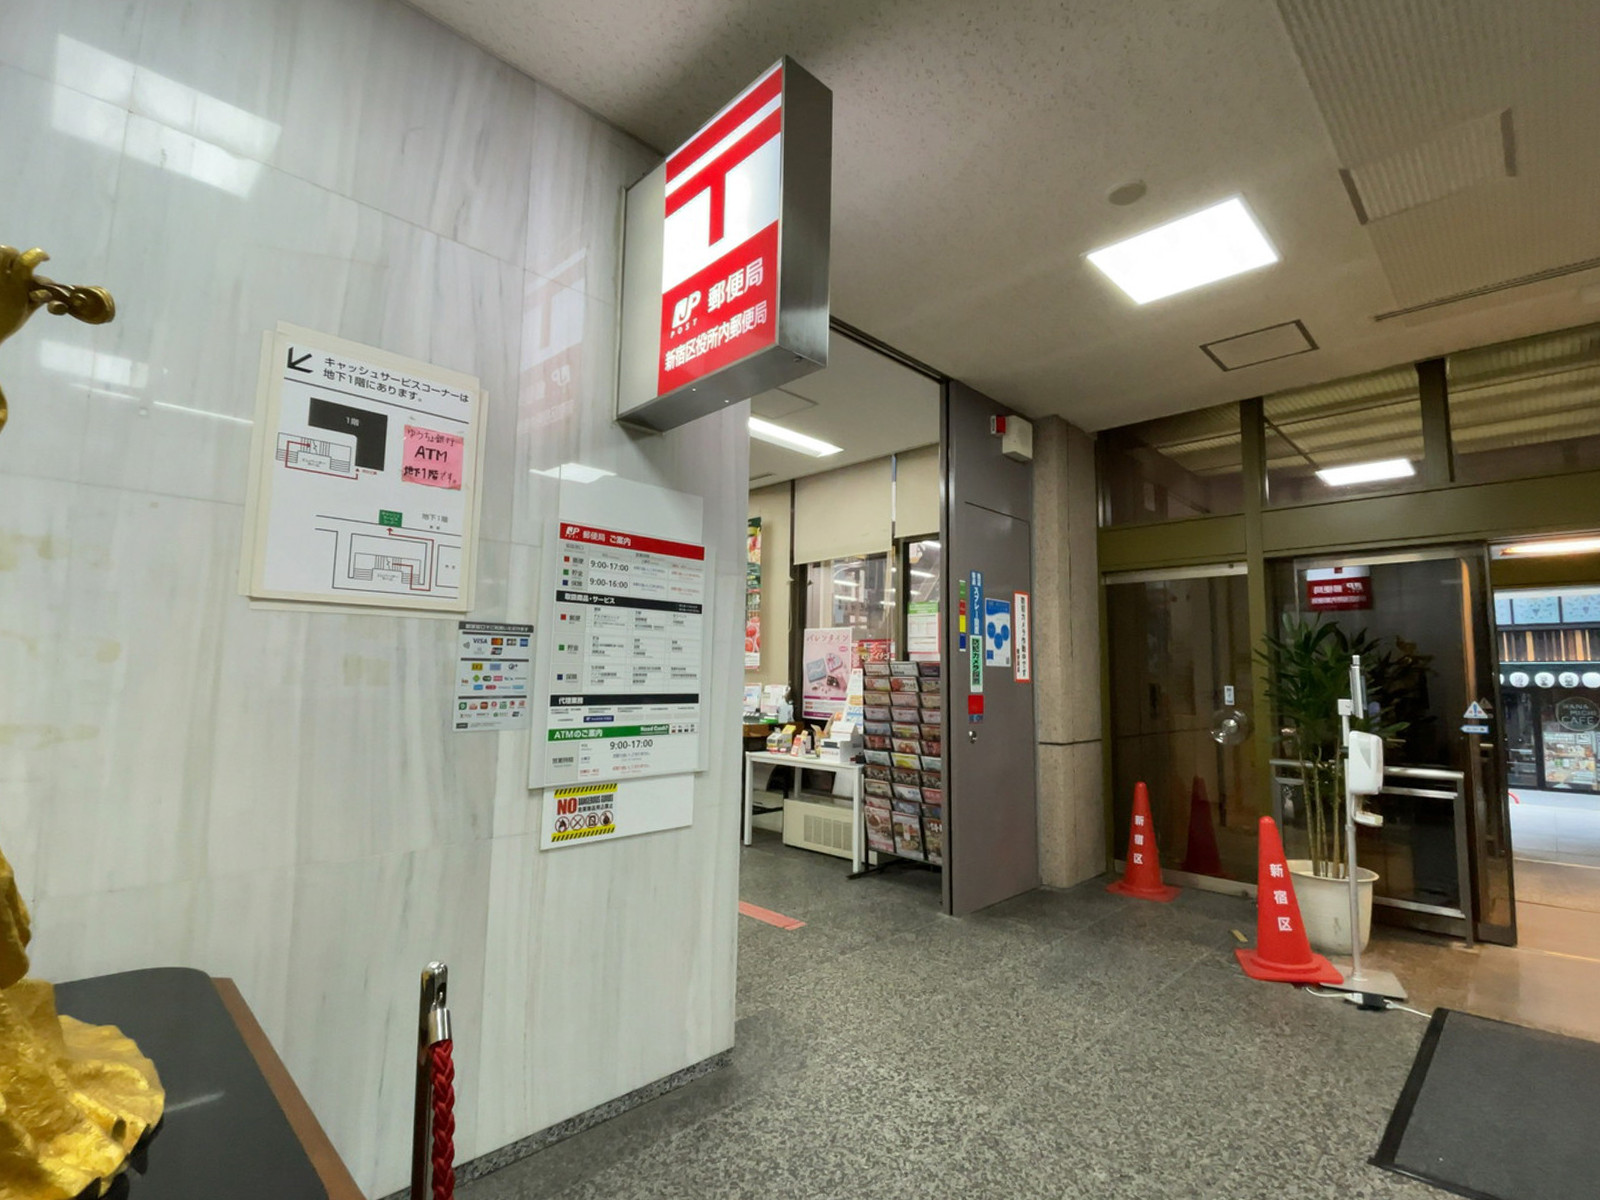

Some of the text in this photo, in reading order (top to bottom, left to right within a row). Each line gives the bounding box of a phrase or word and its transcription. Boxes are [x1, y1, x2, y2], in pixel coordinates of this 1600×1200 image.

[707, 257, 764, 314] 郵便局
[664, 299, 768, 372] 新宿区役所内郵便局
[670, 317, 698, 339] POST
[323, 368, 423, 402] 地下1階にあります。
[324, 357, 470, 403] キャッシュサービスコーナーは
[414, 445, 448, 463] ATM
[590, 560, 629, 572] 9:00-17:00
[589, 577, 629, 589] 9:00-16:00
[1561, 716, 1595, 725] CAFE
[609, 739, 654, 750] 9:00-17:00
[557, 797, 577, 815] NO
[1133, 815, 1145, 866] 新宿区
[1269, 863, 1293, 932] 新宿区
